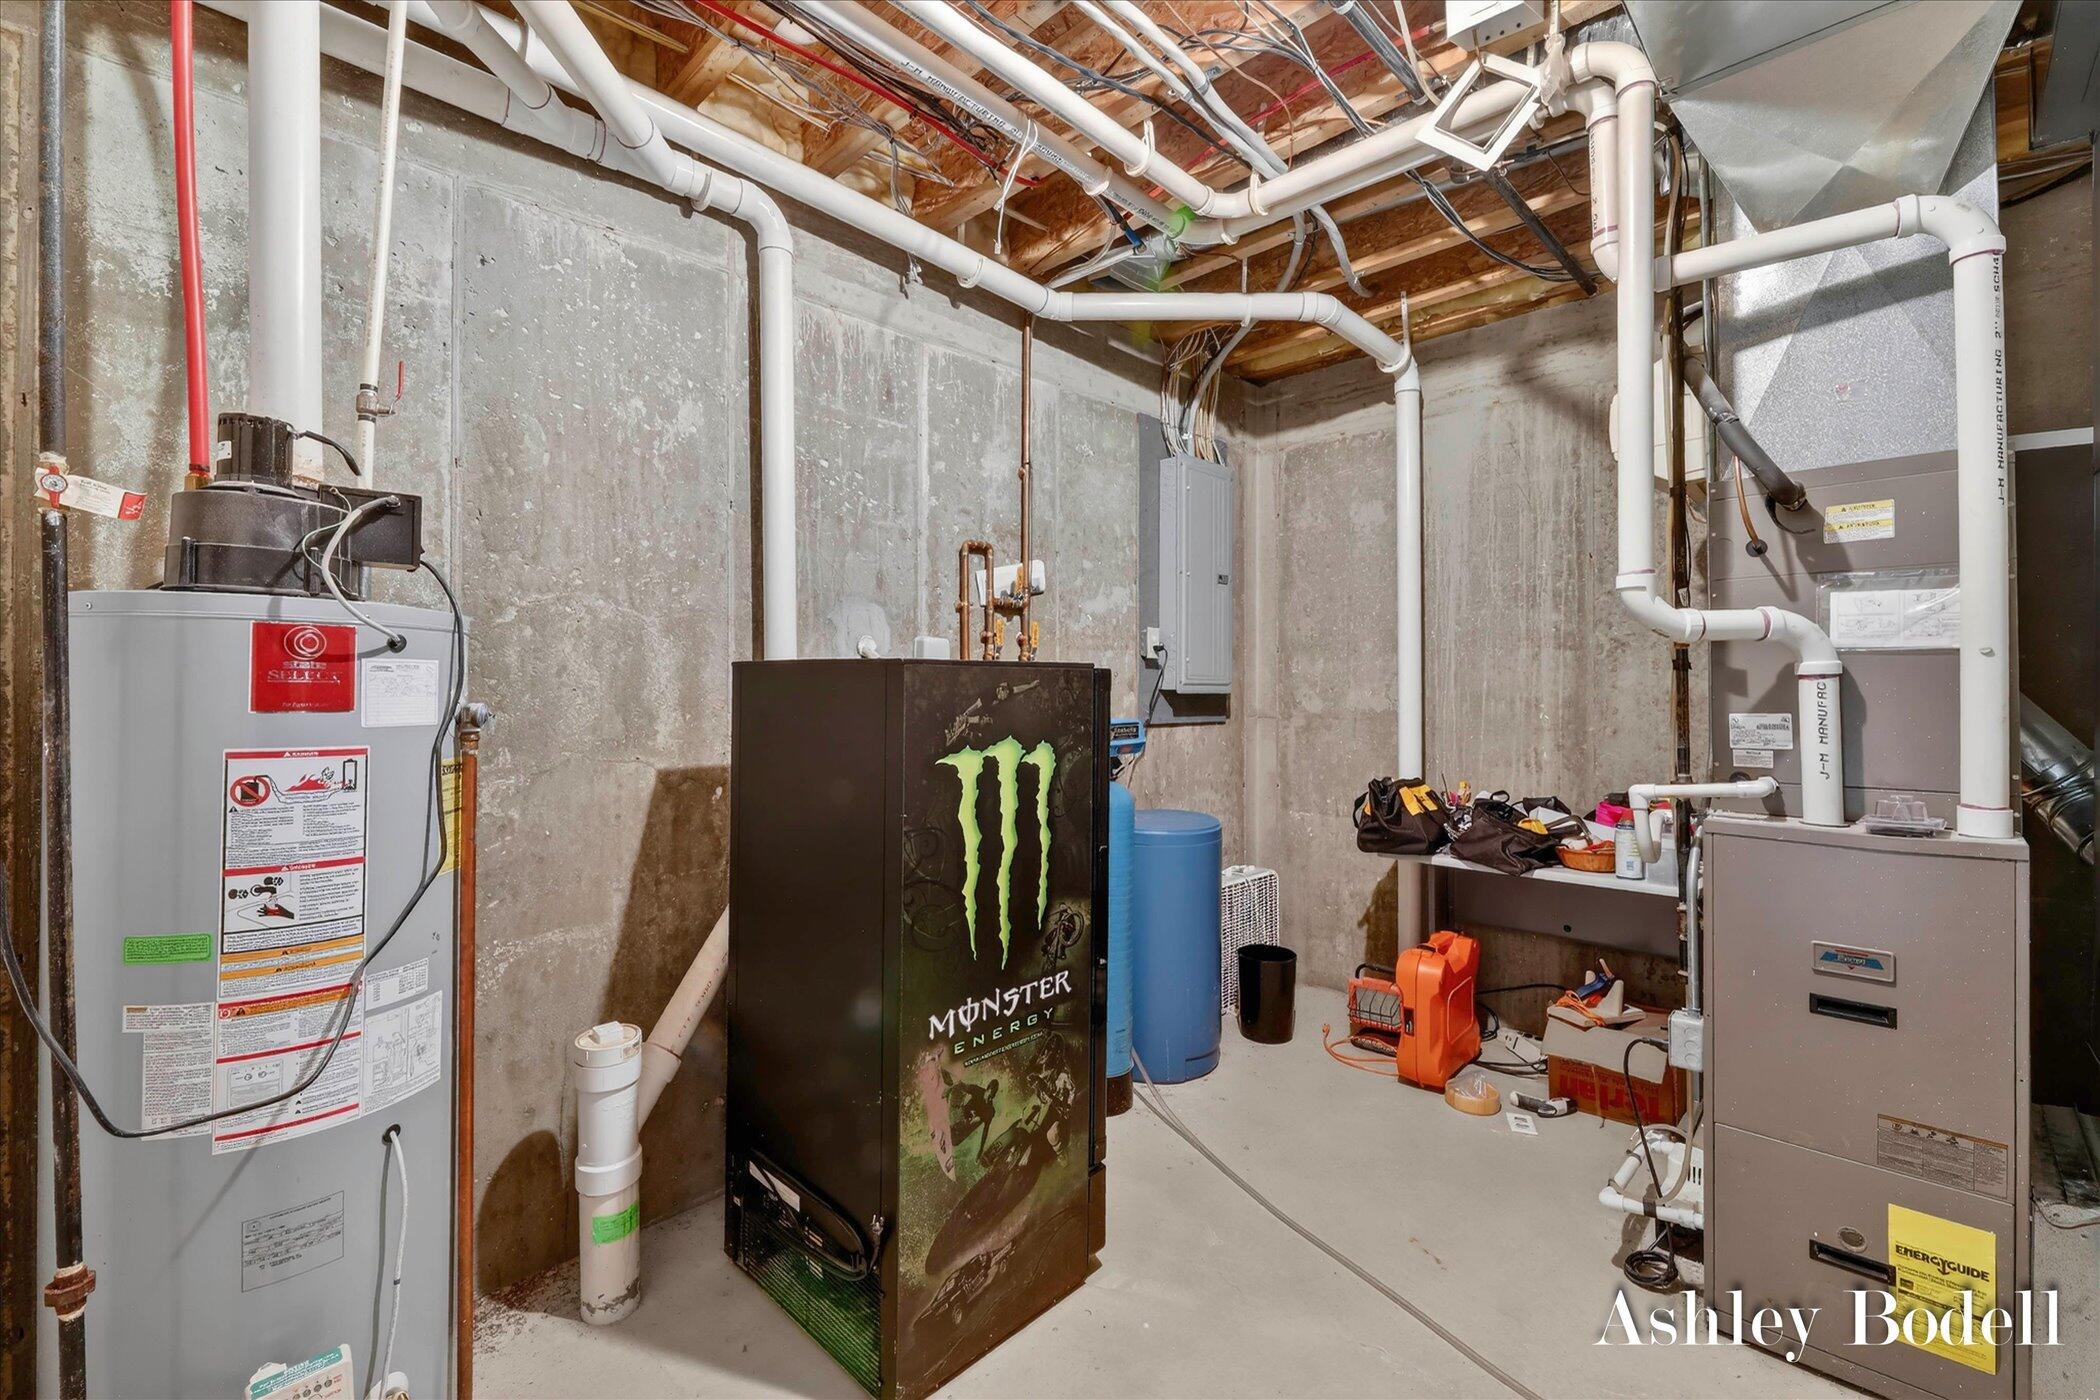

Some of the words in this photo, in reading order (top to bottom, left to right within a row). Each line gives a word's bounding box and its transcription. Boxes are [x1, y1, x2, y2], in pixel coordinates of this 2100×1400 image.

[1994, 348, 2005, 470] MANUFACTURING
[1816, 680, 1829, 745] MANUFAC
[1819, 752, 1831, 781] J-M
[928, 970, 1072, 1040] MONSTER
[954, 1006, 1055, 1055] ENERGY
